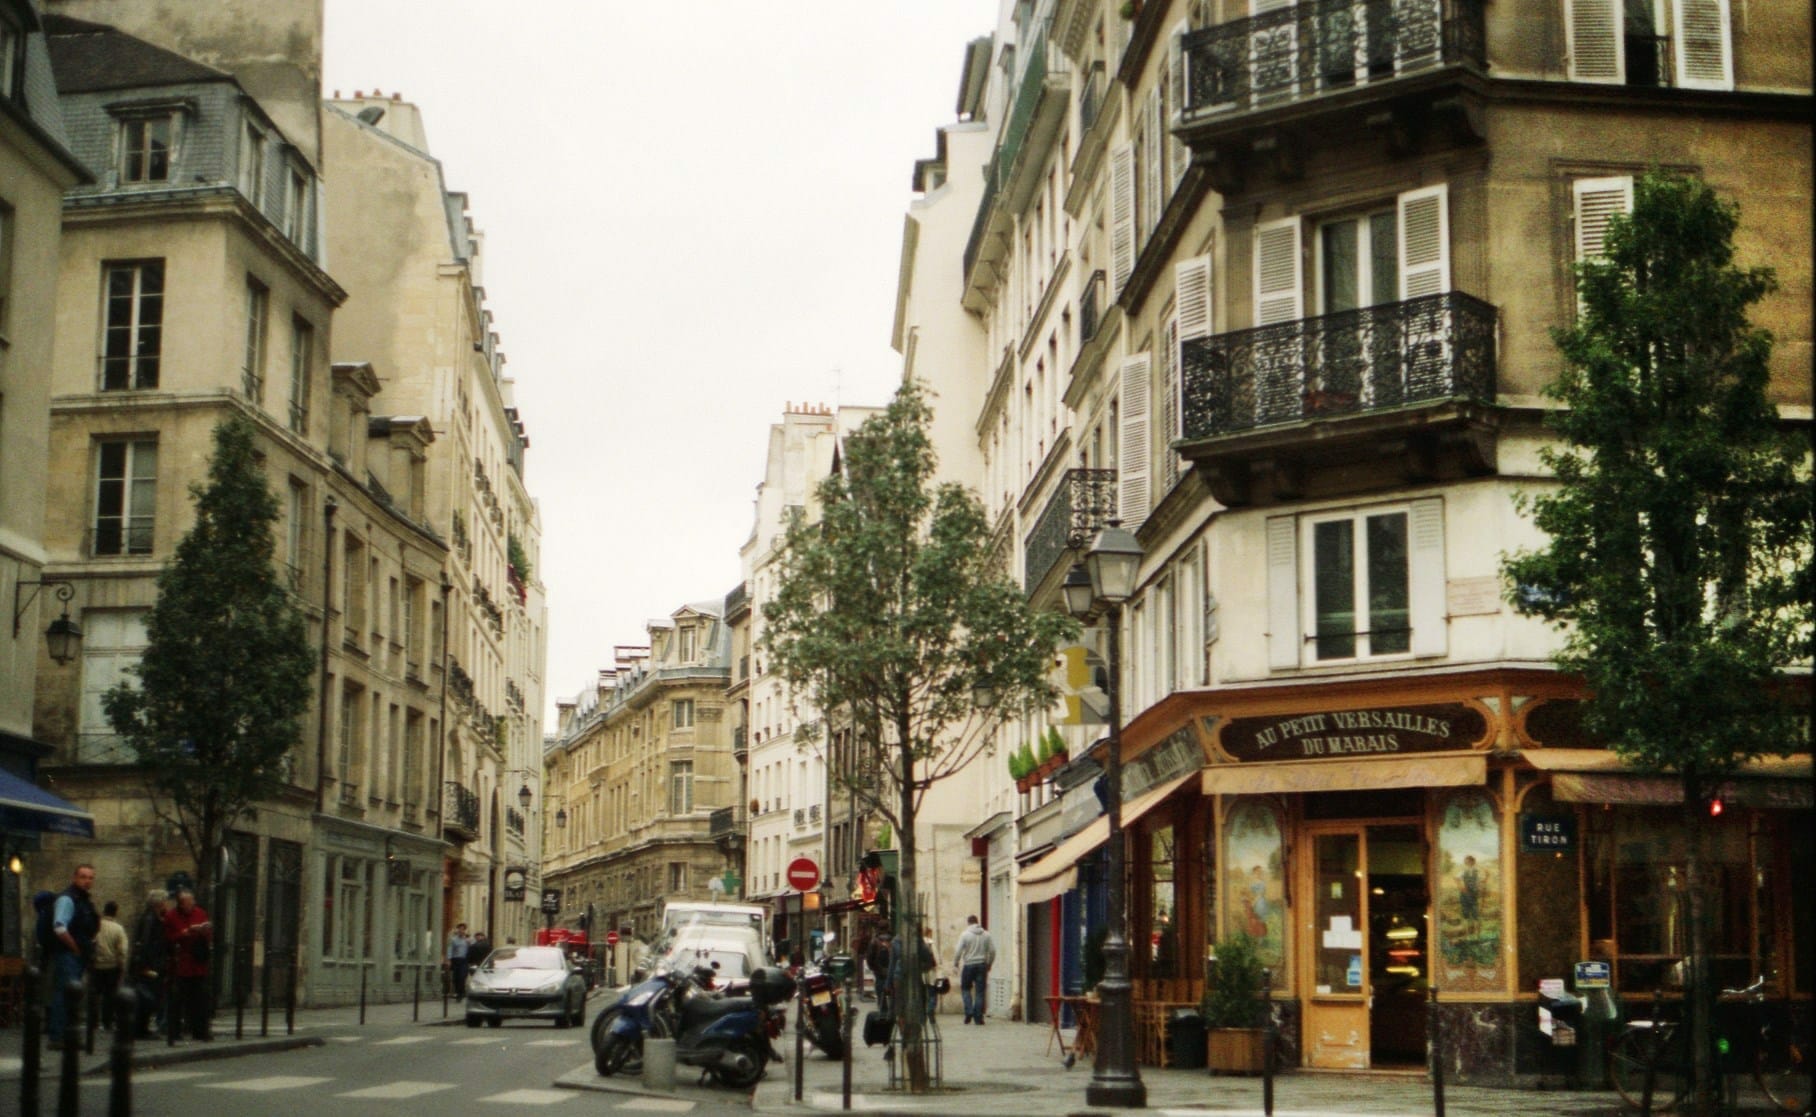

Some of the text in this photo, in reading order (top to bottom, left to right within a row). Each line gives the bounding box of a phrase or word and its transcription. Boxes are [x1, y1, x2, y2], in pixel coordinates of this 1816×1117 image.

[1255, 711, 1450, 750] AU PETIT VERSAILLES
[1302, 734, 1399, 755] DU MARAIS
[1536, 823, 1560, 832] RUE
[1531, 835, 1567, 844] TIRON
